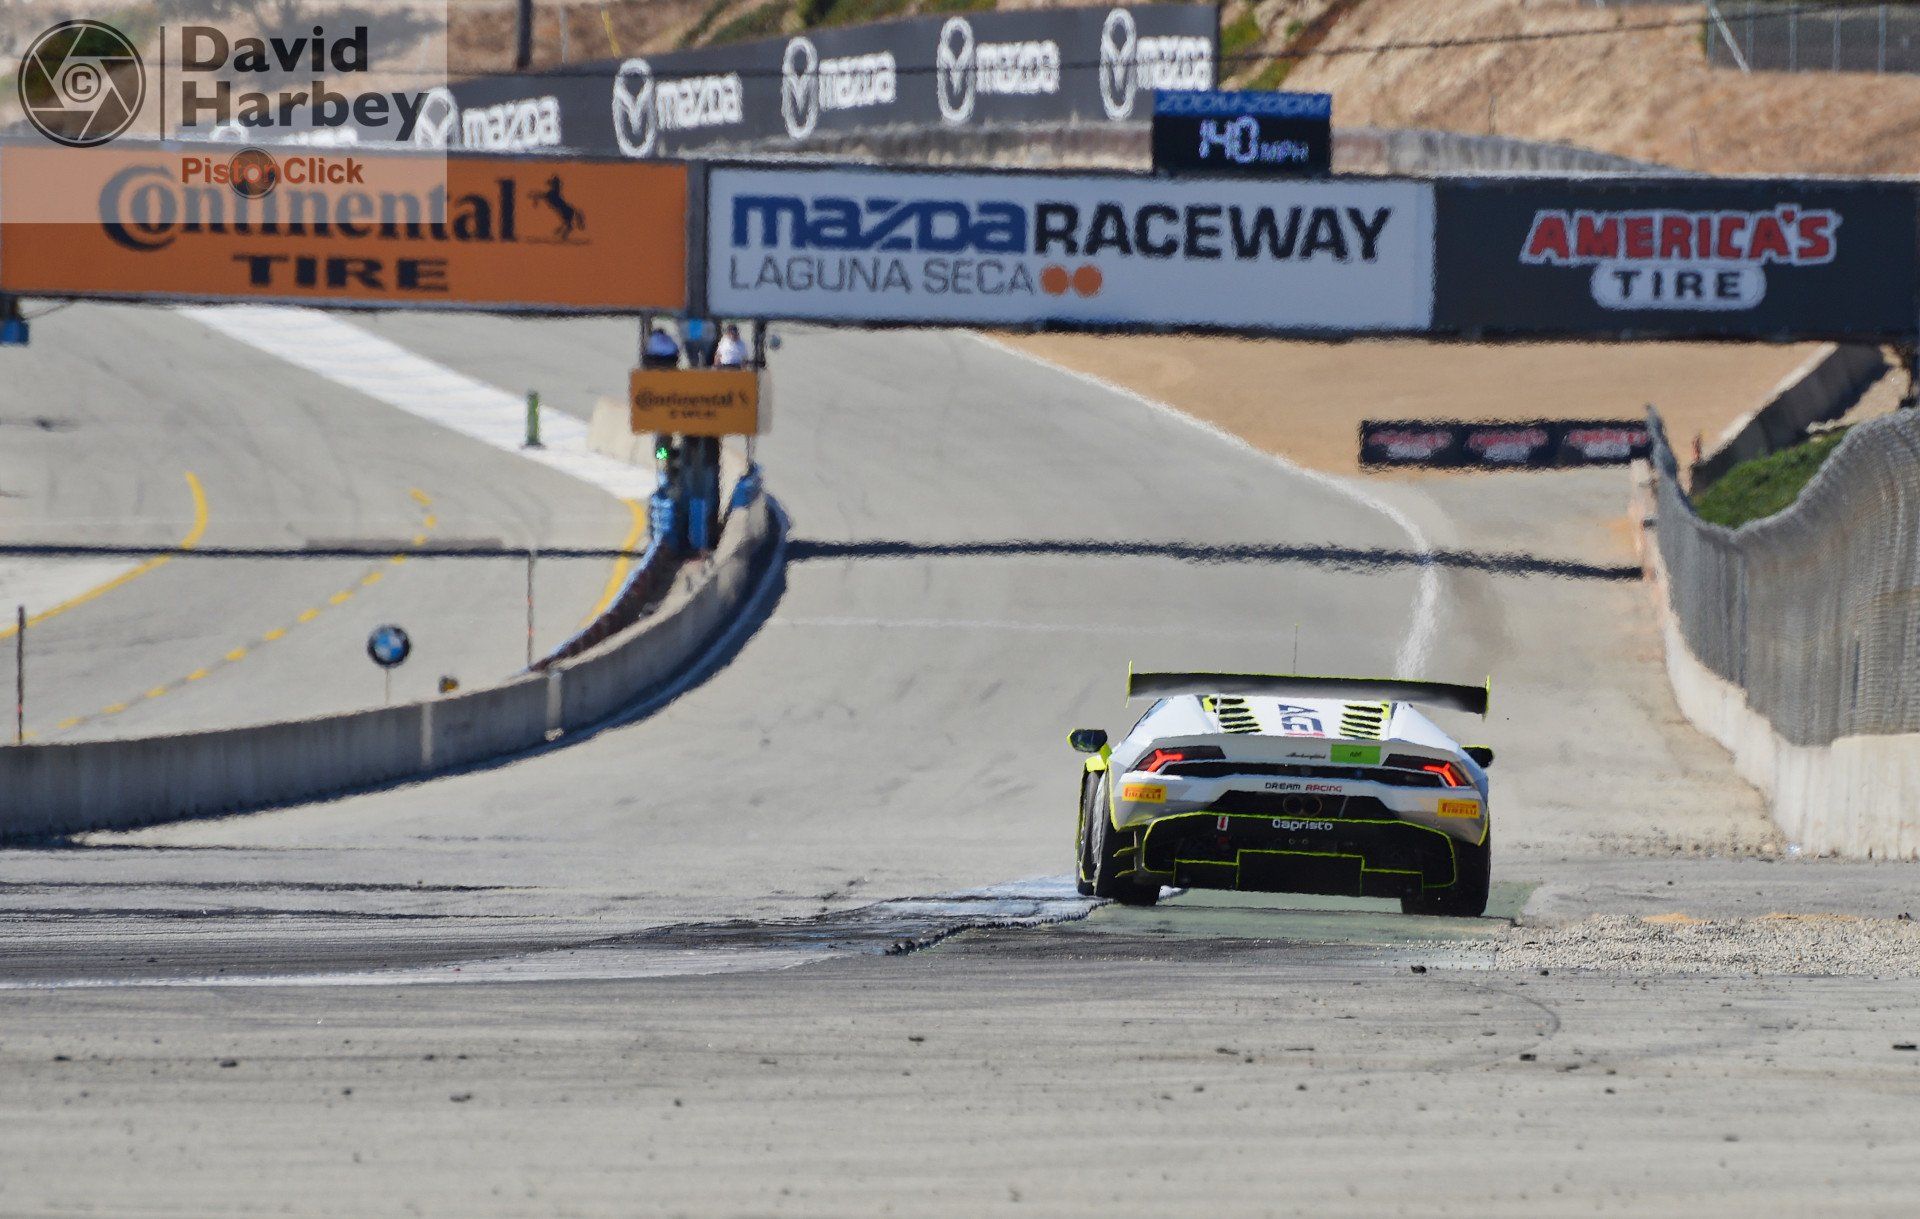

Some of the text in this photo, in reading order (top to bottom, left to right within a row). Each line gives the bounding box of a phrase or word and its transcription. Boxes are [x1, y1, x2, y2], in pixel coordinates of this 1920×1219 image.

[818, 49, 897, 111] mazda
[975, 39, 1060, 93] mazda
[1136, 35, 1213, 90] mazda
[459, 96, 562, 147] mazda
[654, 72, 744, 129] mazda
[99, 165, 517, 251] Continental
[1033, 202, 1393, 262] RACEWAY
[1520, 205, 1843, 265] AMERICA'S
[231, 253, 450, 292] TIRE
[729, 254, 1035, 296] LAGUNA SECA
[1612, 269, 1743, 301] TIRE
[1264, 782, 1343, 793] DREAM RACING
[1272, 818, 1334, 832] Capristo
